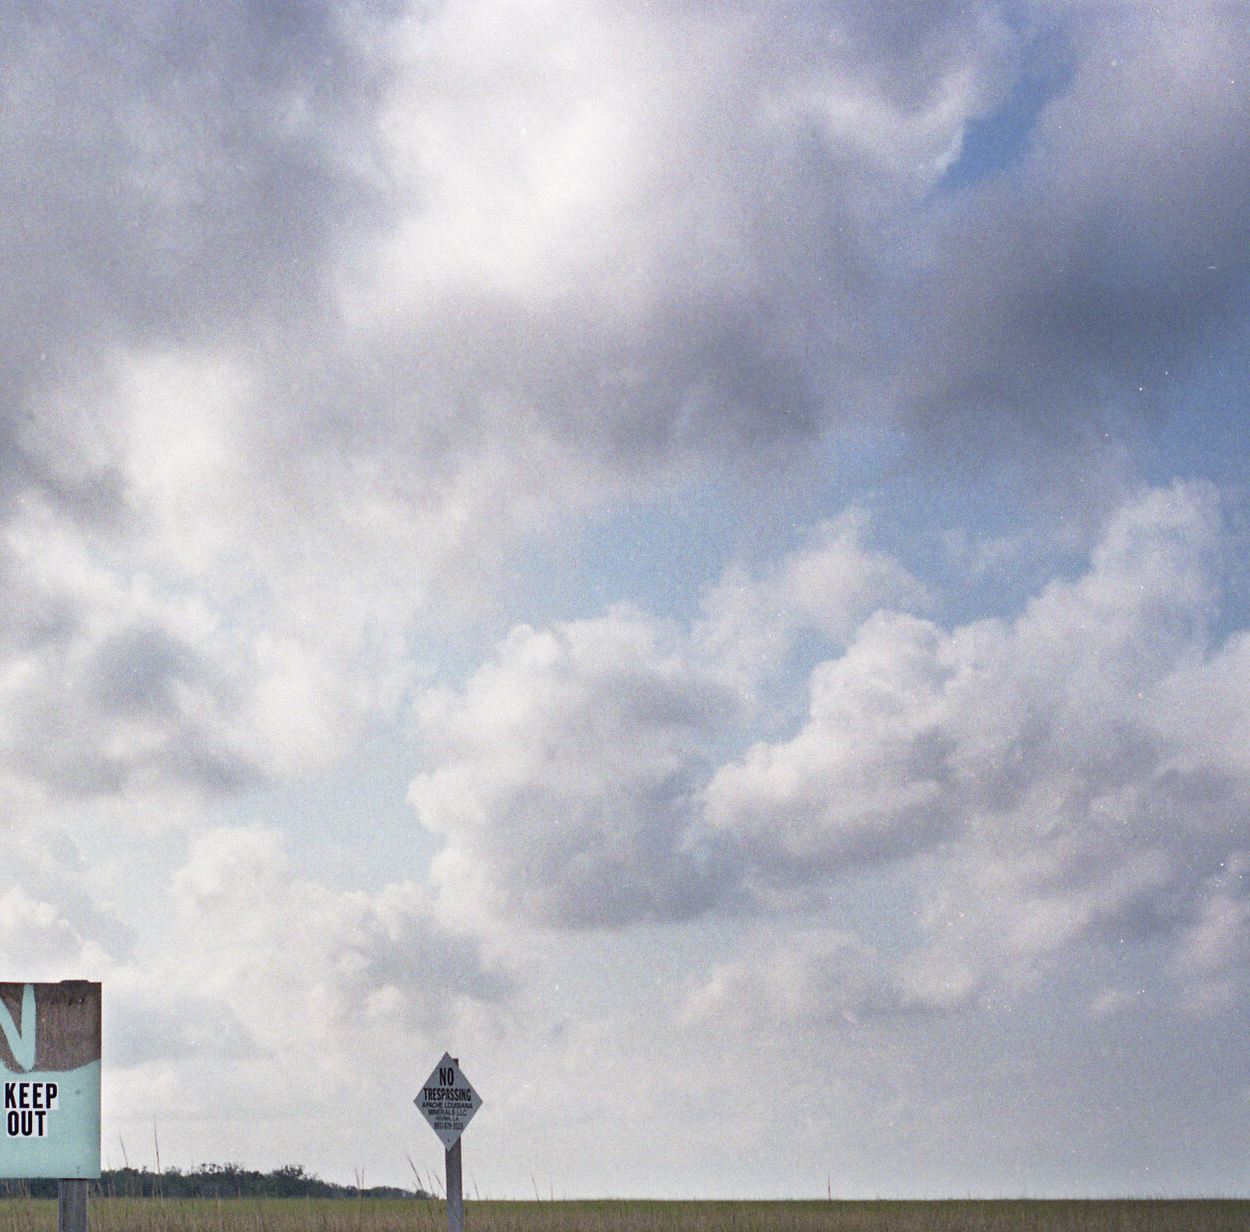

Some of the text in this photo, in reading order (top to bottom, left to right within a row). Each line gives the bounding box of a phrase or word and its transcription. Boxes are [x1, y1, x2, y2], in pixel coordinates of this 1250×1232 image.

[439, 1067, 454, 1086] NO
[5, 1082, 58, 1109] KEEP
[423, 1088, 472, 1101] TRESPASSING
[7, 1110, 47, 1136] OUT
